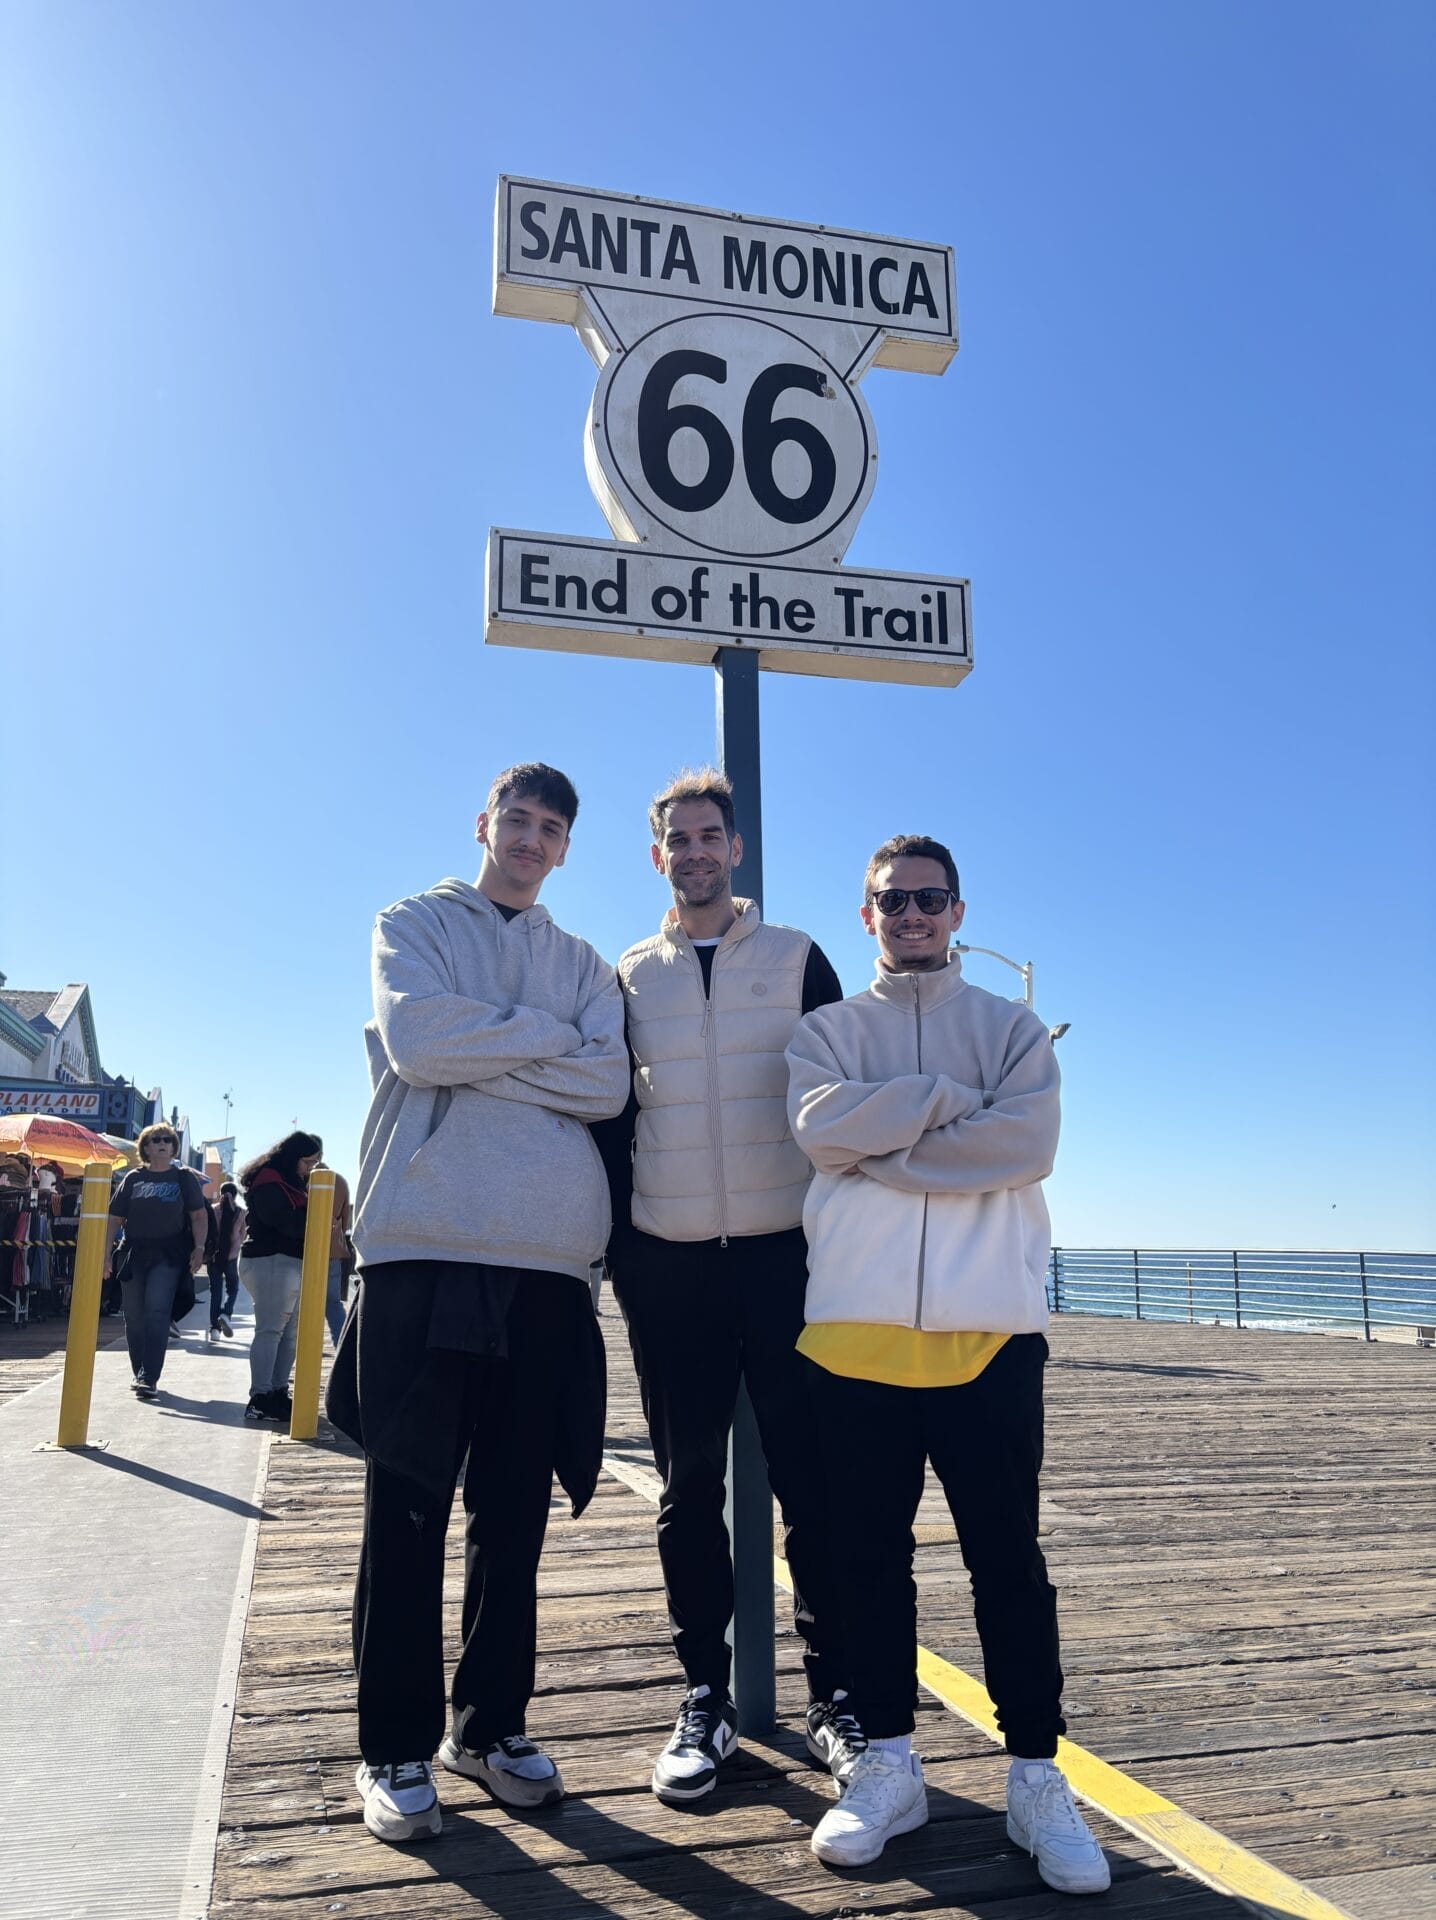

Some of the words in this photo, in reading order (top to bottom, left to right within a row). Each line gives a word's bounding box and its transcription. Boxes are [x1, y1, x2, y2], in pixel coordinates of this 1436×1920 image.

[519, 200, 701, 285] SANTA
[722, 235, 940, 320] MONICA
[637, 349, 837, 525] 66
[519, 553, 628, 615] End
[650, 566, 710, 623] of
[728, 572, 816, 634] the
[833, 586, 949, 646] Trail
[6, 1106, 81, 1114] ARCADE
